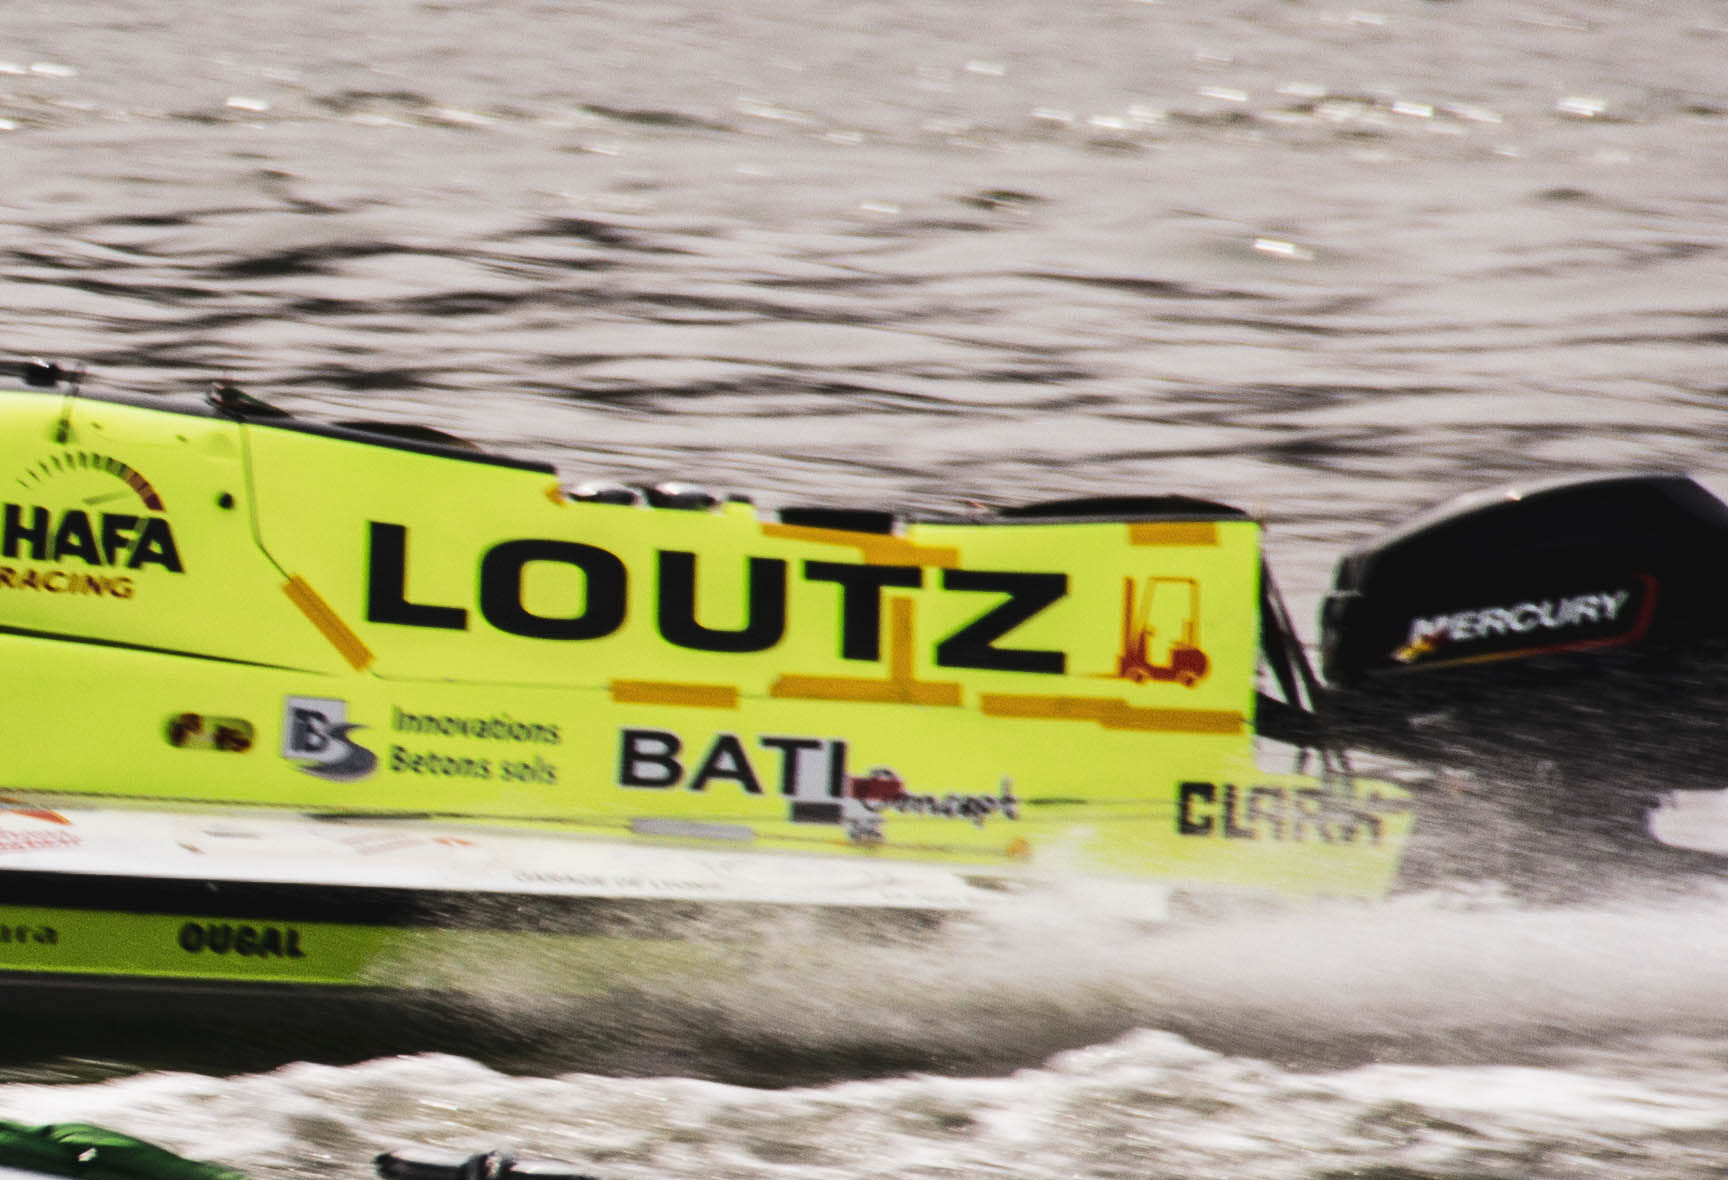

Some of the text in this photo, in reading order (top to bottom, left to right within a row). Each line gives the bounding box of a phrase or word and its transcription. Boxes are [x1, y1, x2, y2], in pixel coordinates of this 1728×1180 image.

[0, 503, 185, 574] HAFA
[365, 519, 1070, 676] LOUTZ
[1409, 590, 1629, 641] MERCURY
[392, 705, 562, 745] Innovations
[500, 756, 559, 785] sols
[618, 728, 847, 799] BATI
